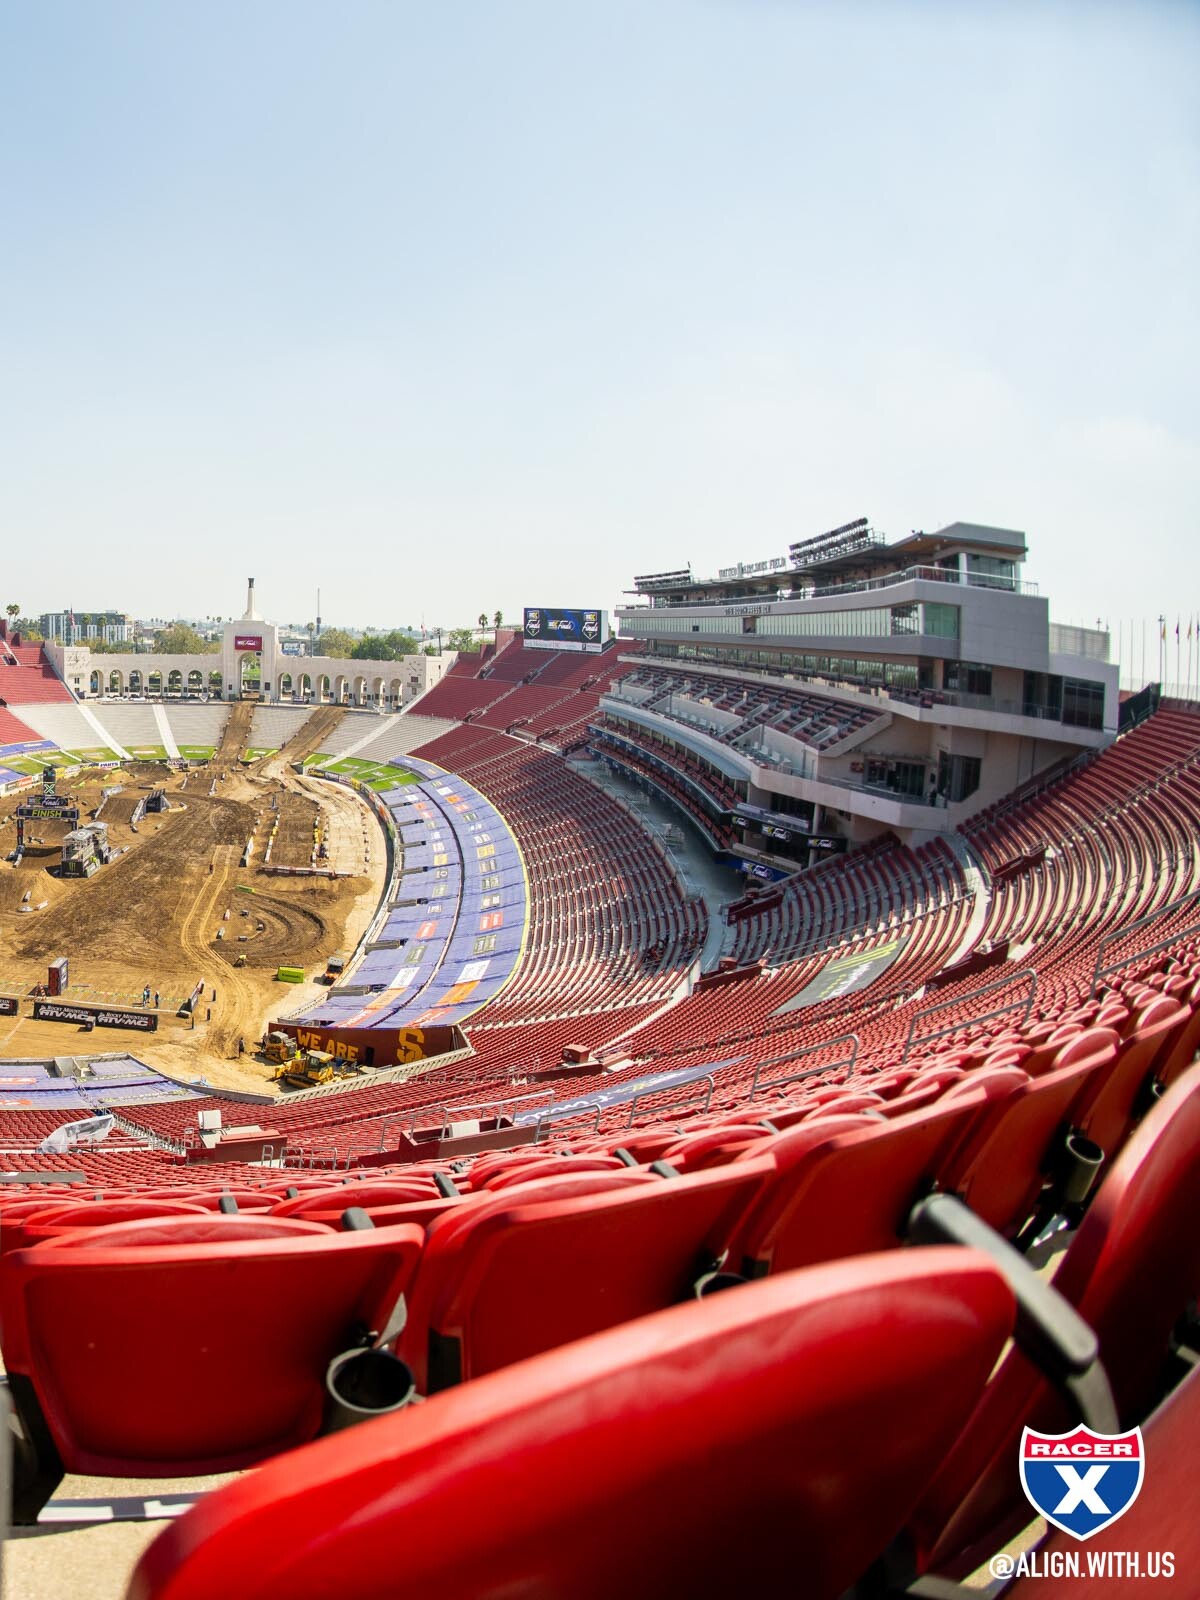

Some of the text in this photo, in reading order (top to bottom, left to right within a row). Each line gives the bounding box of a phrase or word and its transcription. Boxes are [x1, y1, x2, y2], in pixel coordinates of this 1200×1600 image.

[47, 1004, 89, 1015] ROCKY MOUNTAIN
[123, 1013, 149, 1021] MOUNTAIN
[297, 1029, 359, 1062] WE ARE
